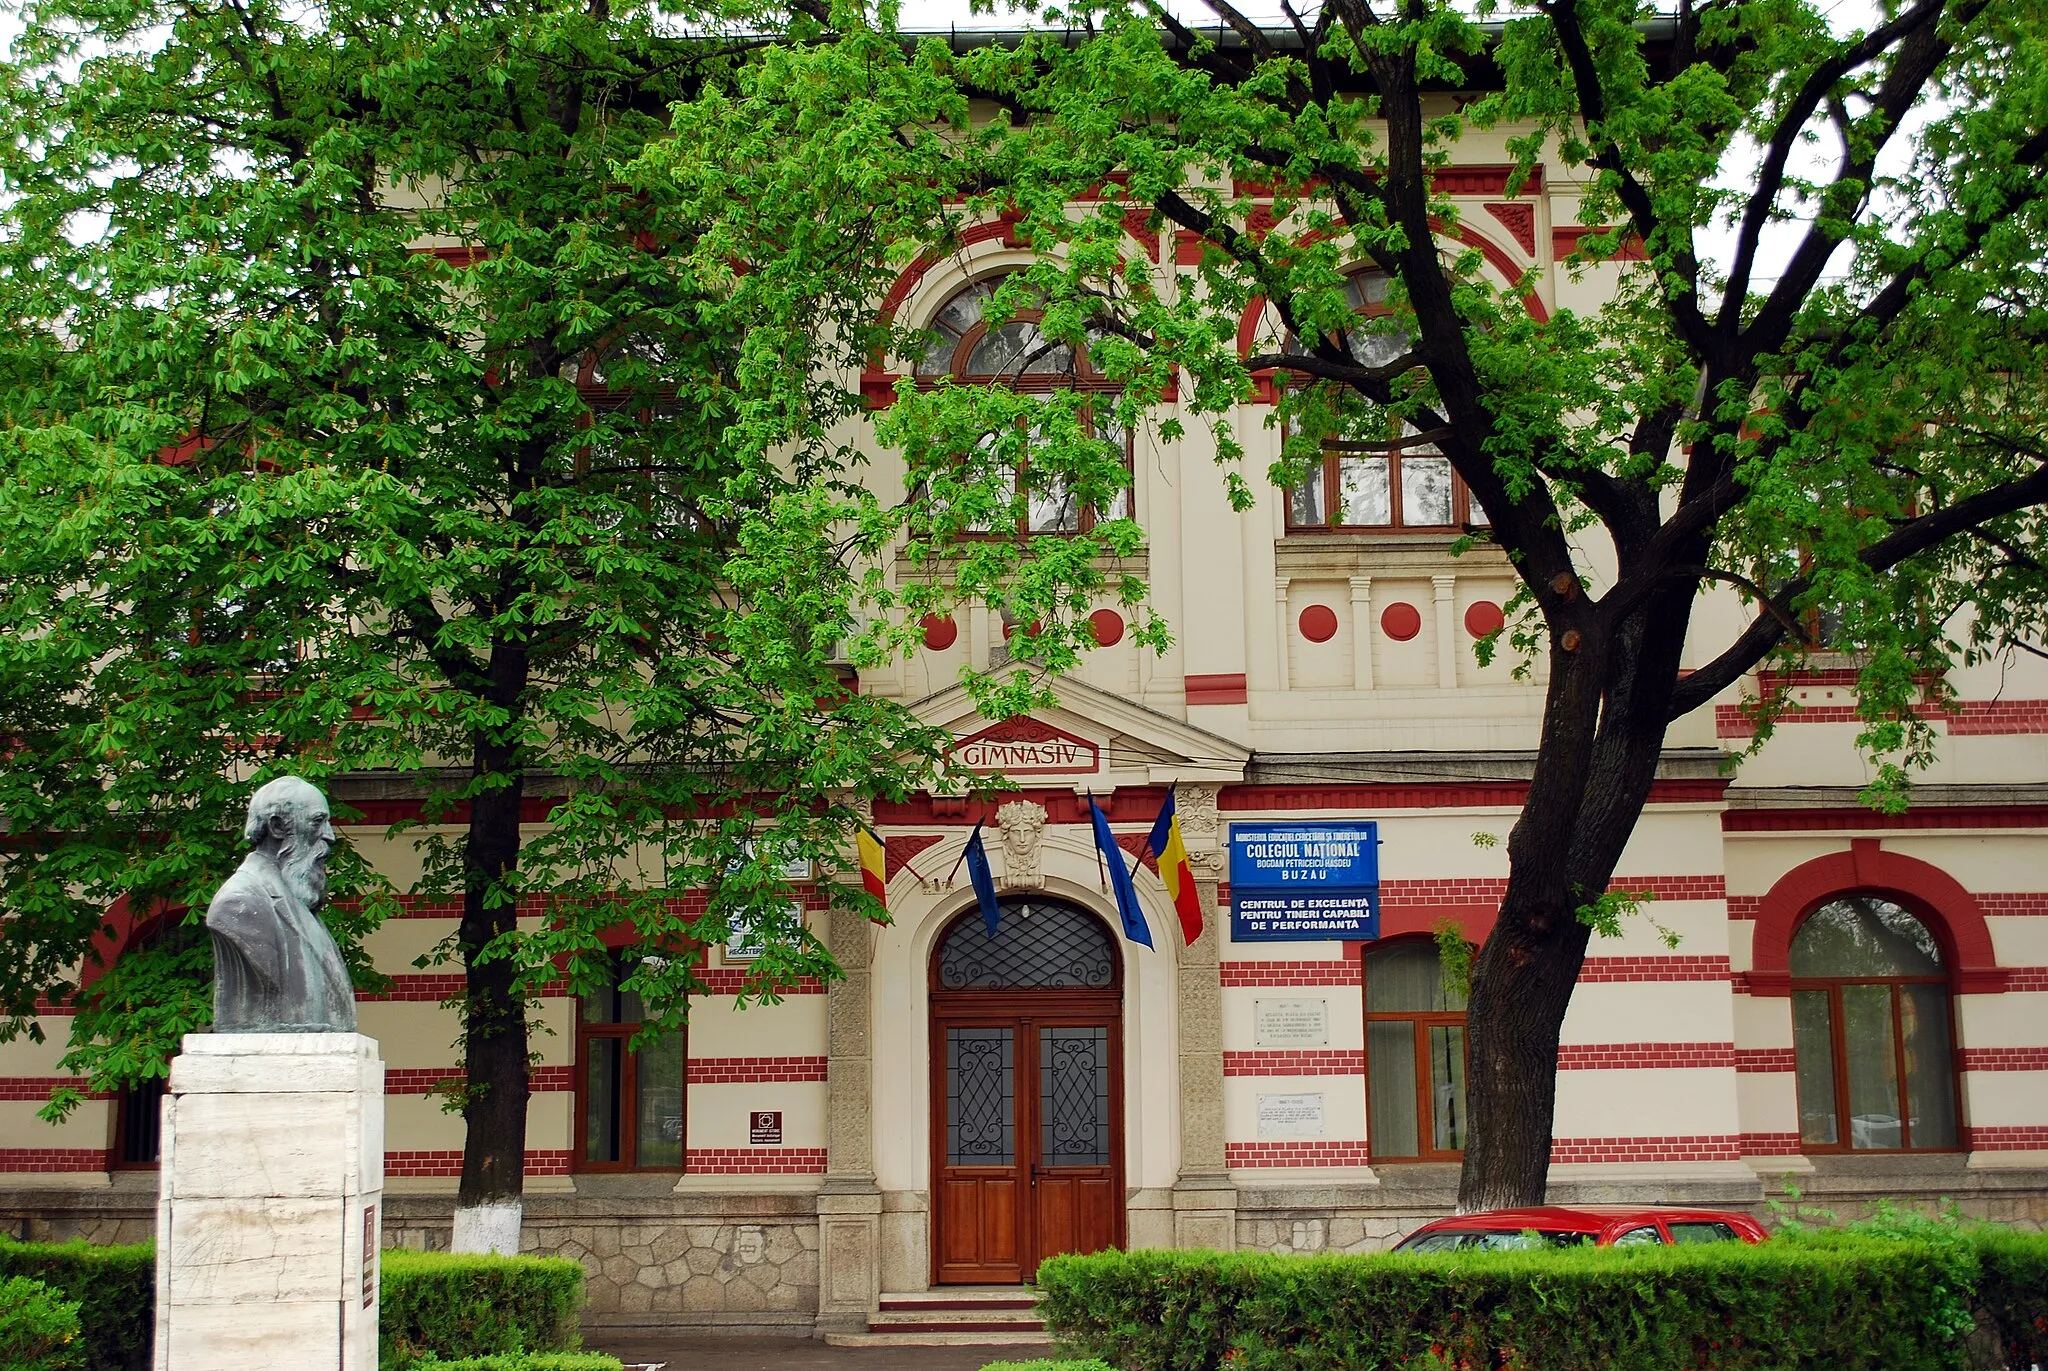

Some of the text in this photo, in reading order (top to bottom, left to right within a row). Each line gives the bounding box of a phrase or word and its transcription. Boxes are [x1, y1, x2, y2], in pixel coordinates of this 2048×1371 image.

[963, 745, 1077, 766] GIMNASIV
[1246, 843, 1360, 859] COLEGIUL NAȚIONAL
[1256, 859, 1284, 868] BOGDAN
[1285, 858, 1324, 868] PETRICEICU
[1240, 900, 1288, 909] CENTRUL
[1291, 900, 1305, 908] DE
[1240, 909, 1370, 920] PENTRU TINERI CAPABILI
[1251, 921, 1266, 930] DE
